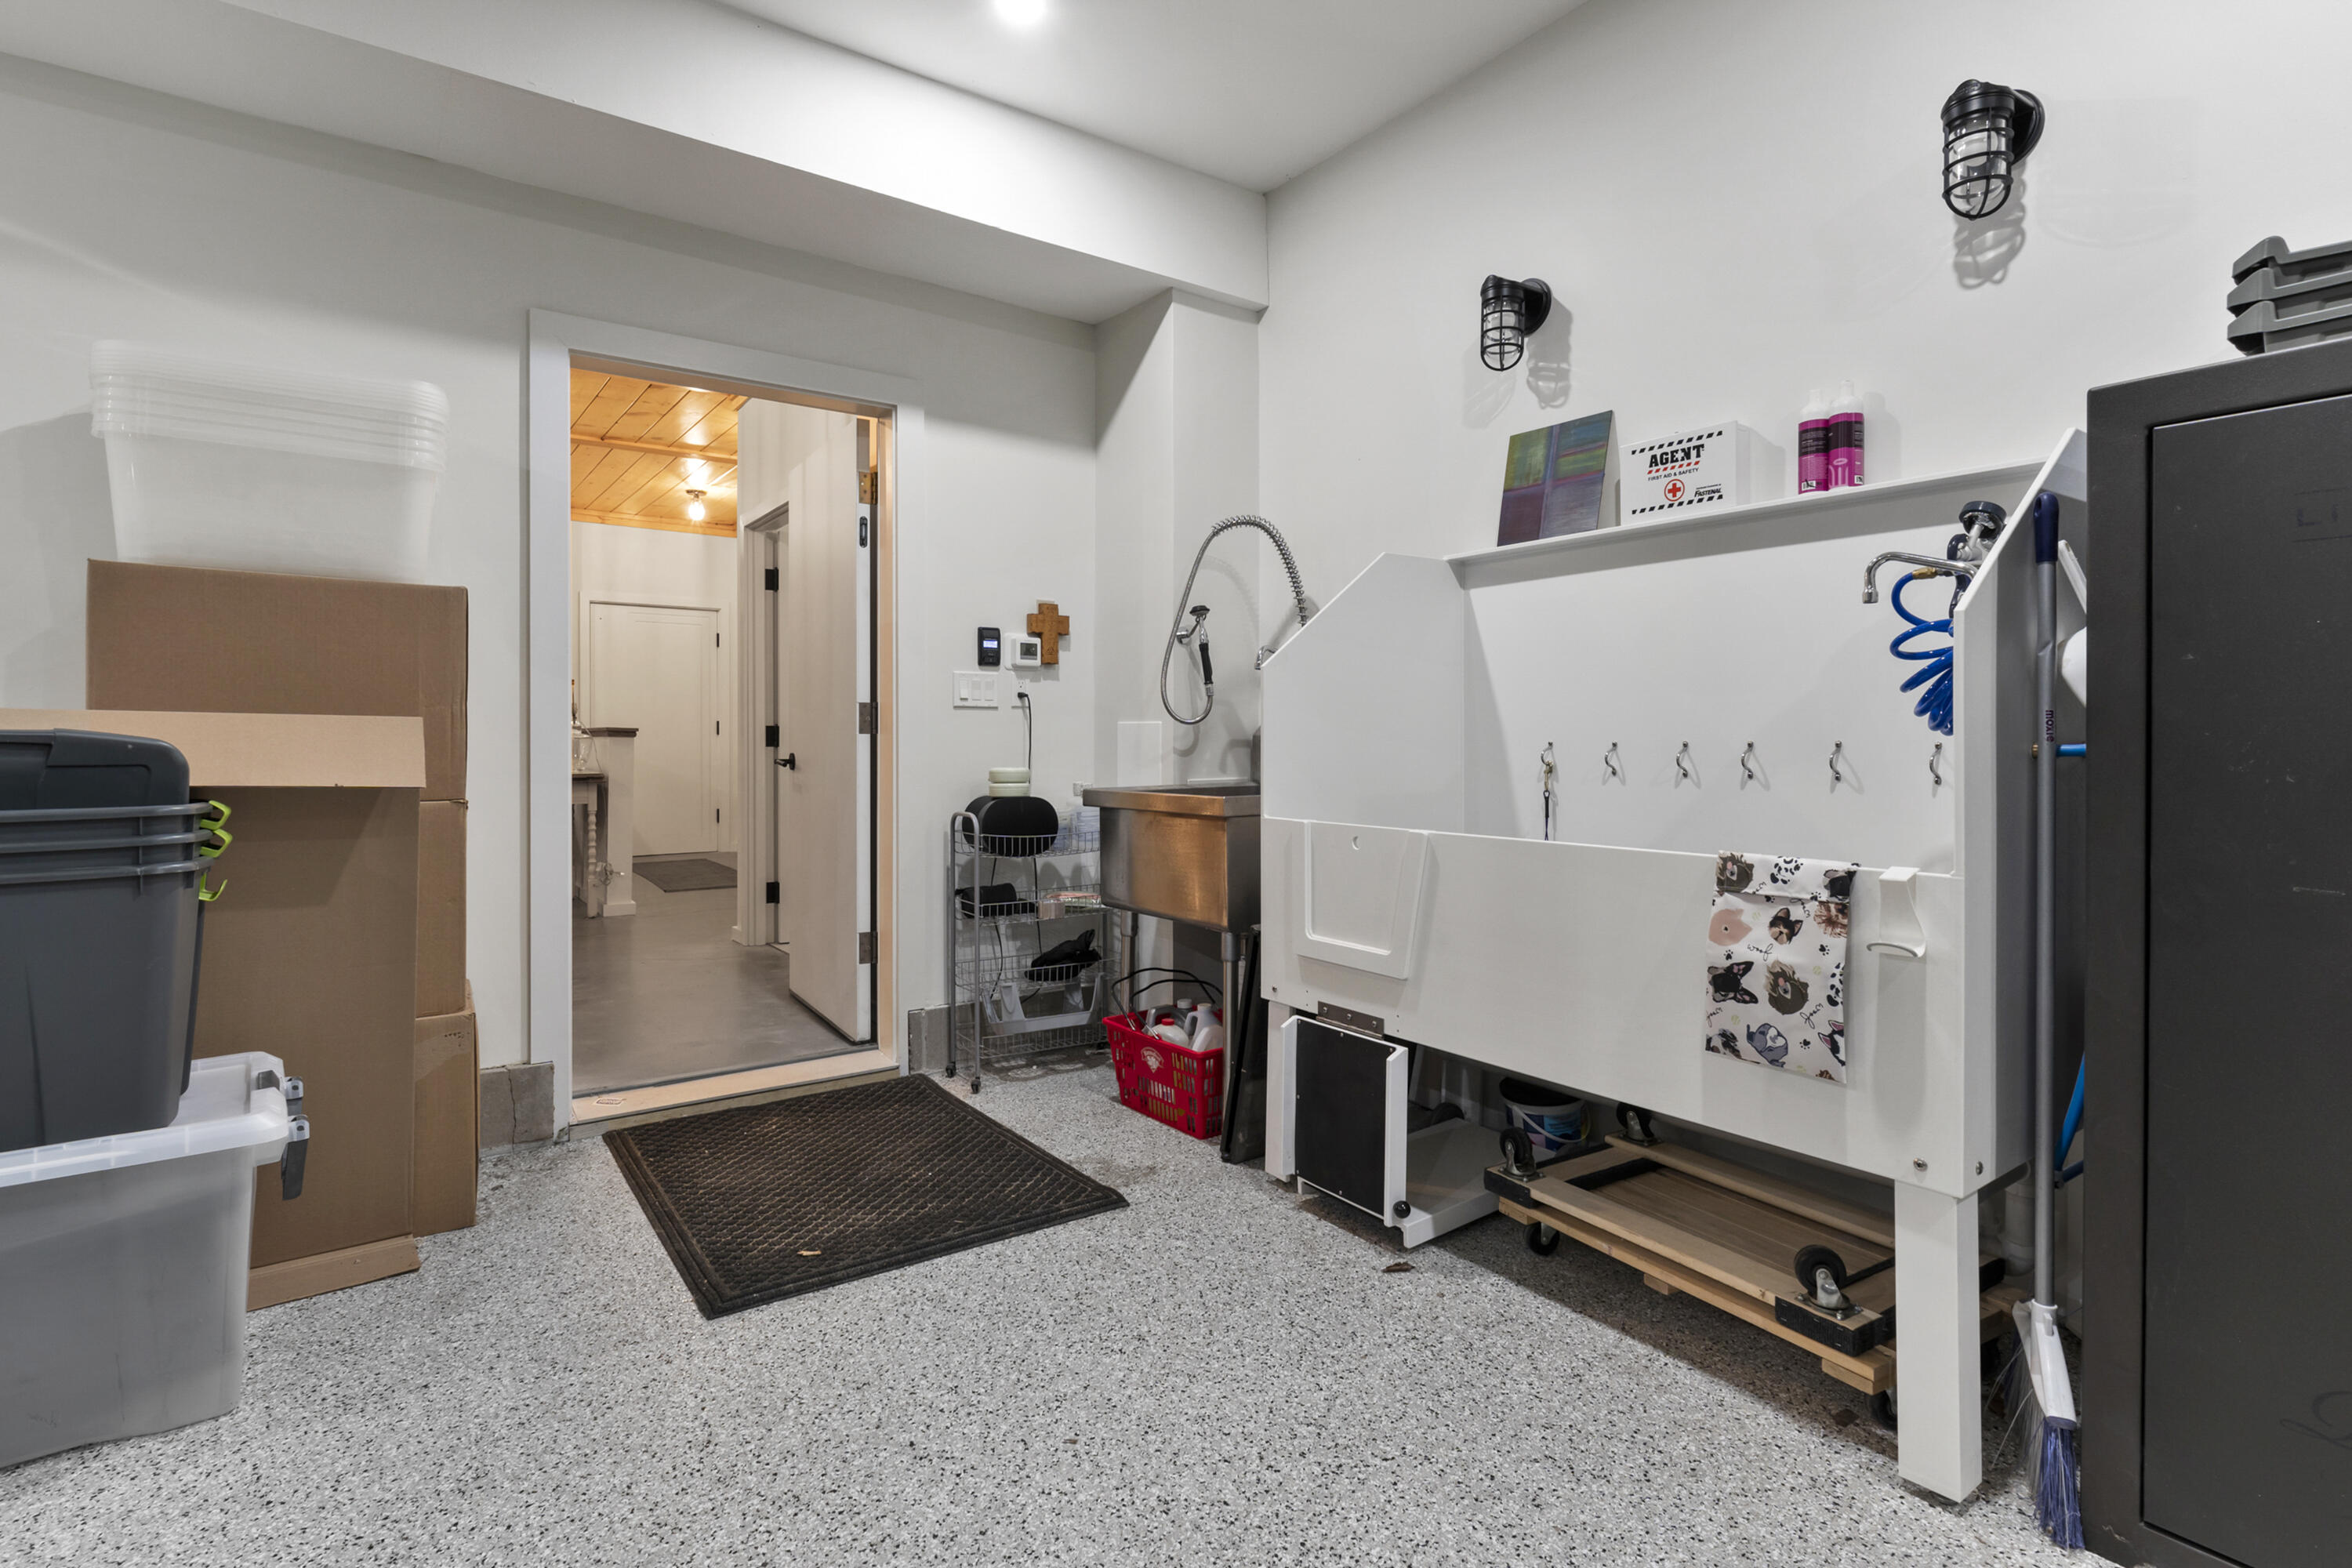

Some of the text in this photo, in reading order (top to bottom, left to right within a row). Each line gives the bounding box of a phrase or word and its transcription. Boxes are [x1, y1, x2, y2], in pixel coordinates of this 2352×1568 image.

[1649, 444, 1704, 468] AGENT
[2045, 710, 2054, 742] moxie
[1748, 943, 1773, 961] woof
[1799, 1003, 1824, 1029] woof
